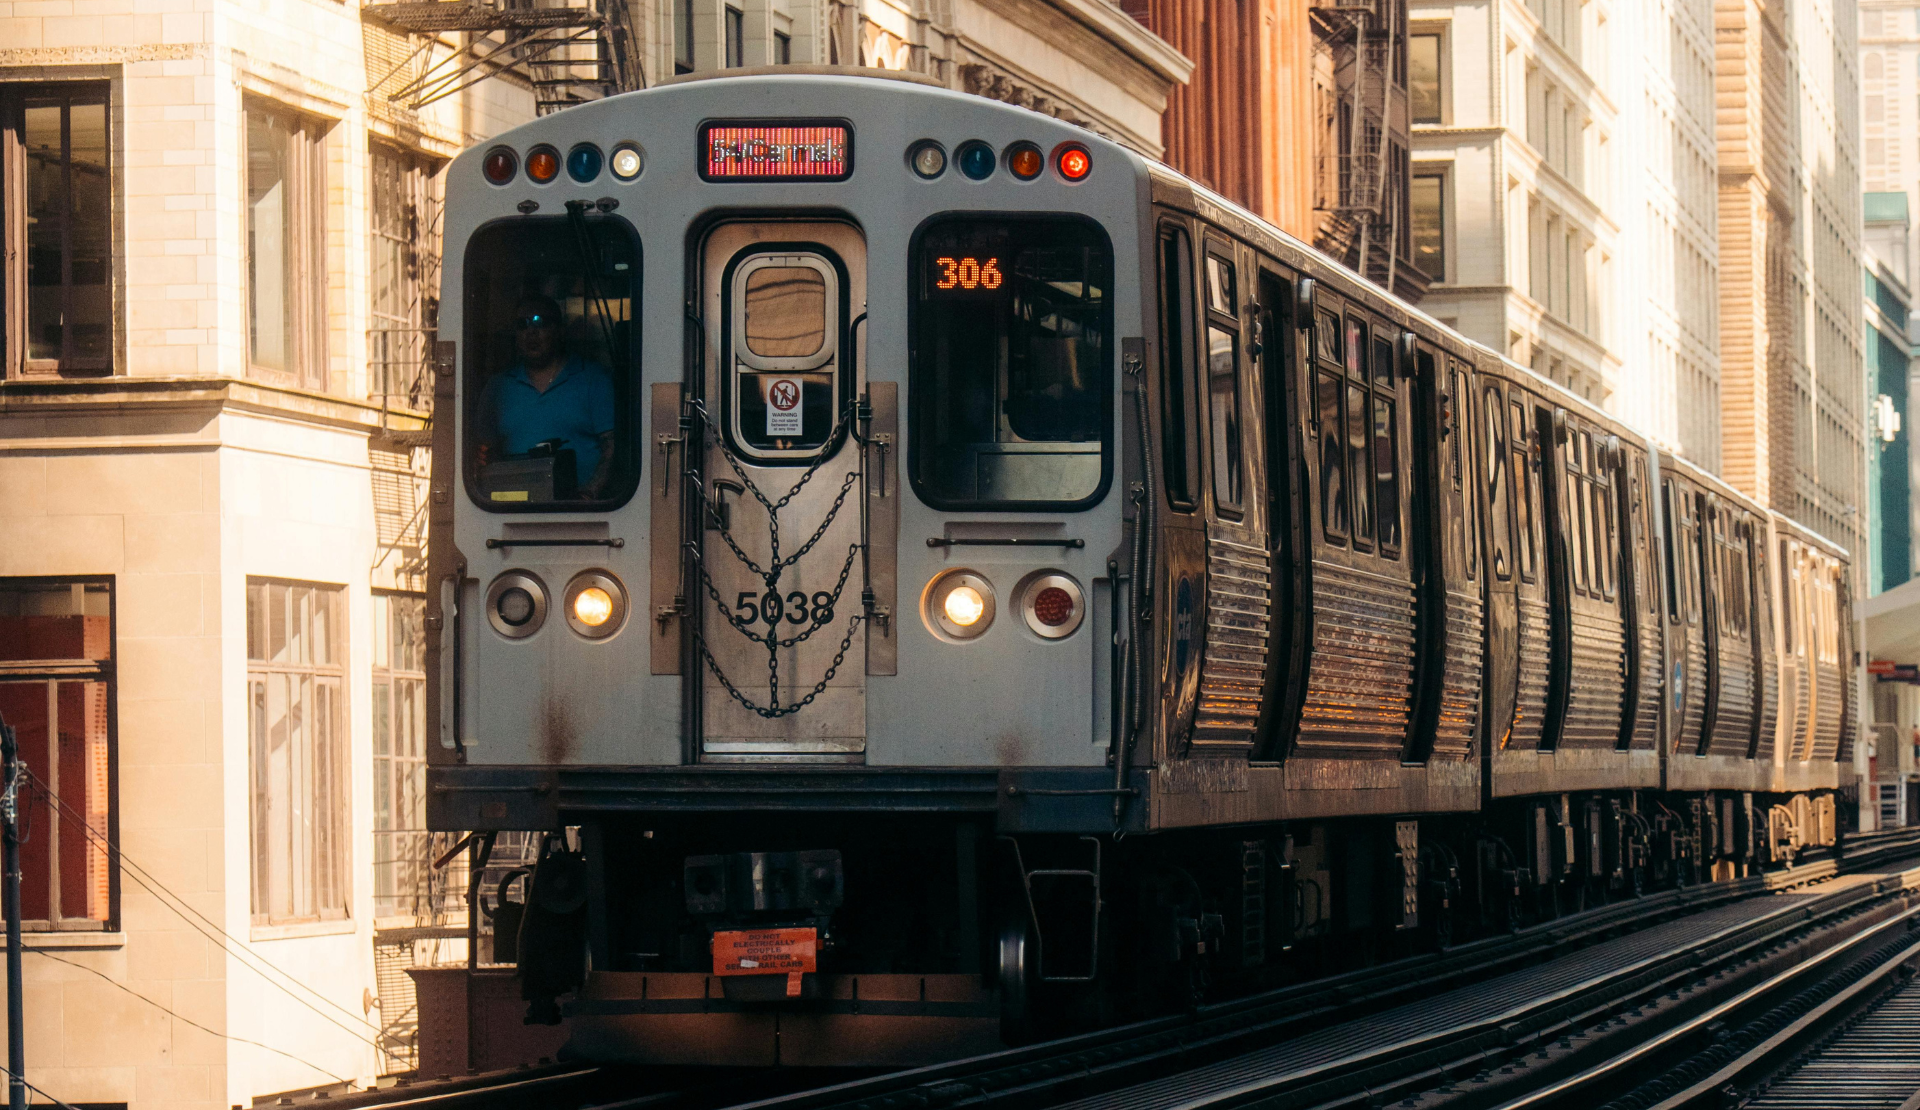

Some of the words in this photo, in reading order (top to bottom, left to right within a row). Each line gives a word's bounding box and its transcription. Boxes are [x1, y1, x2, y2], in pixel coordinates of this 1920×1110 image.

[936, 257, 1002, 289] 306
[735, 591, 834, 625] 5038
[733, 940, 796, 948] ELECTRICALLY
